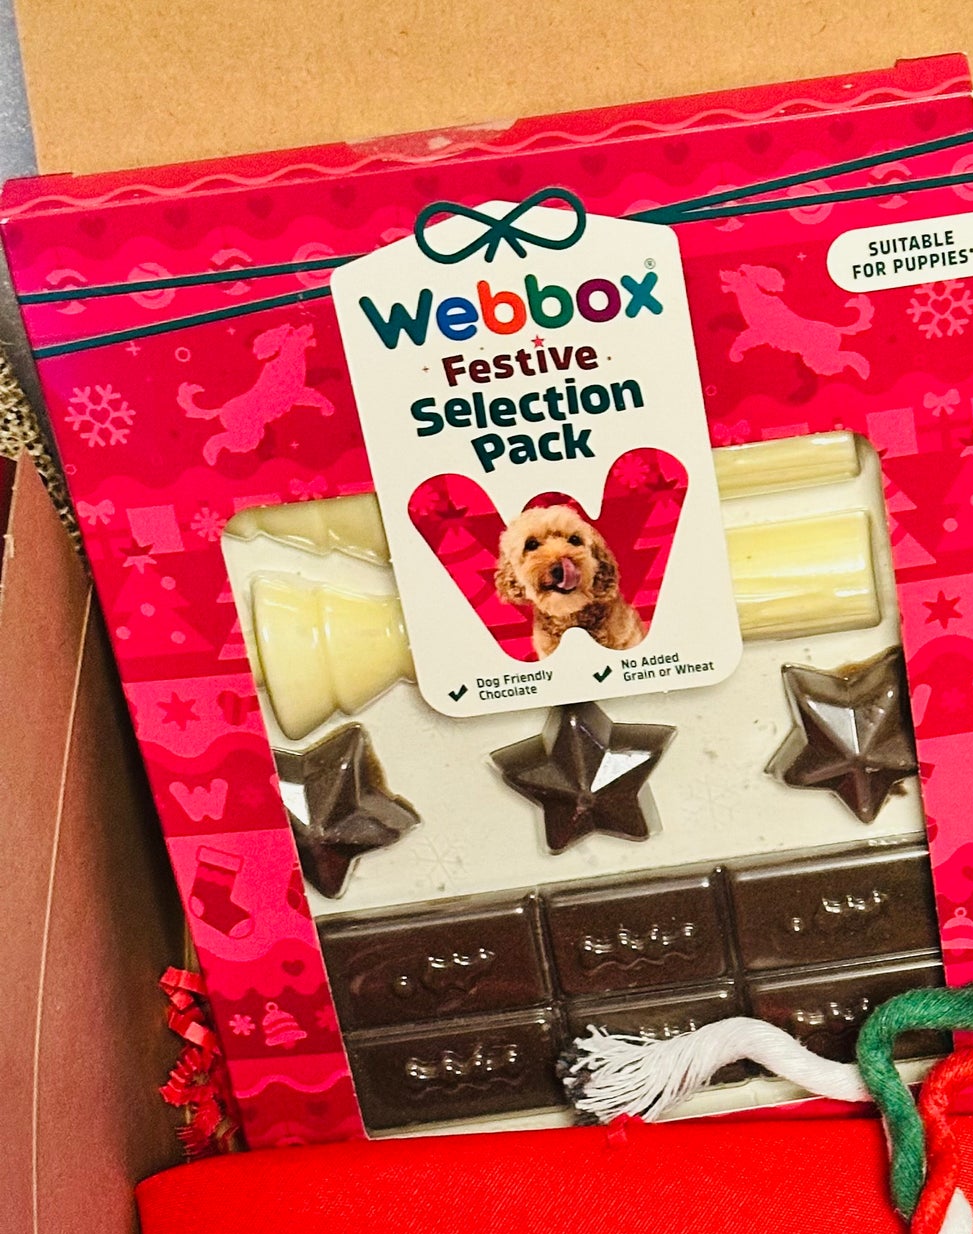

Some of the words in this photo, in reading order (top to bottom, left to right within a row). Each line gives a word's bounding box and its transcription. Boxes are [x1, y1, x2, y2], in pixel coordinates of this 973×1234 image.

[868, 230, 955, 256] SUITABLE
[852, 261, 886, 279] FOR
[358, 271, 663, 349] Webbox
[442, 336, 599, 387] Festive
[410, 377, 644, 437] Selection
[471, 423, 595, 473] Pack
[621, 658, 637, 670] No
[641, 652, 680, 667] Added
[623, 668, 655, 682] Grain
[659, 667, 672, 678] or
[676, 661, 715, 675] Wheat
[476, 677, 500, 689] Dog
[503, 669, 553, 684] Friendly
[478, 684, 538, 700] Chocolate
